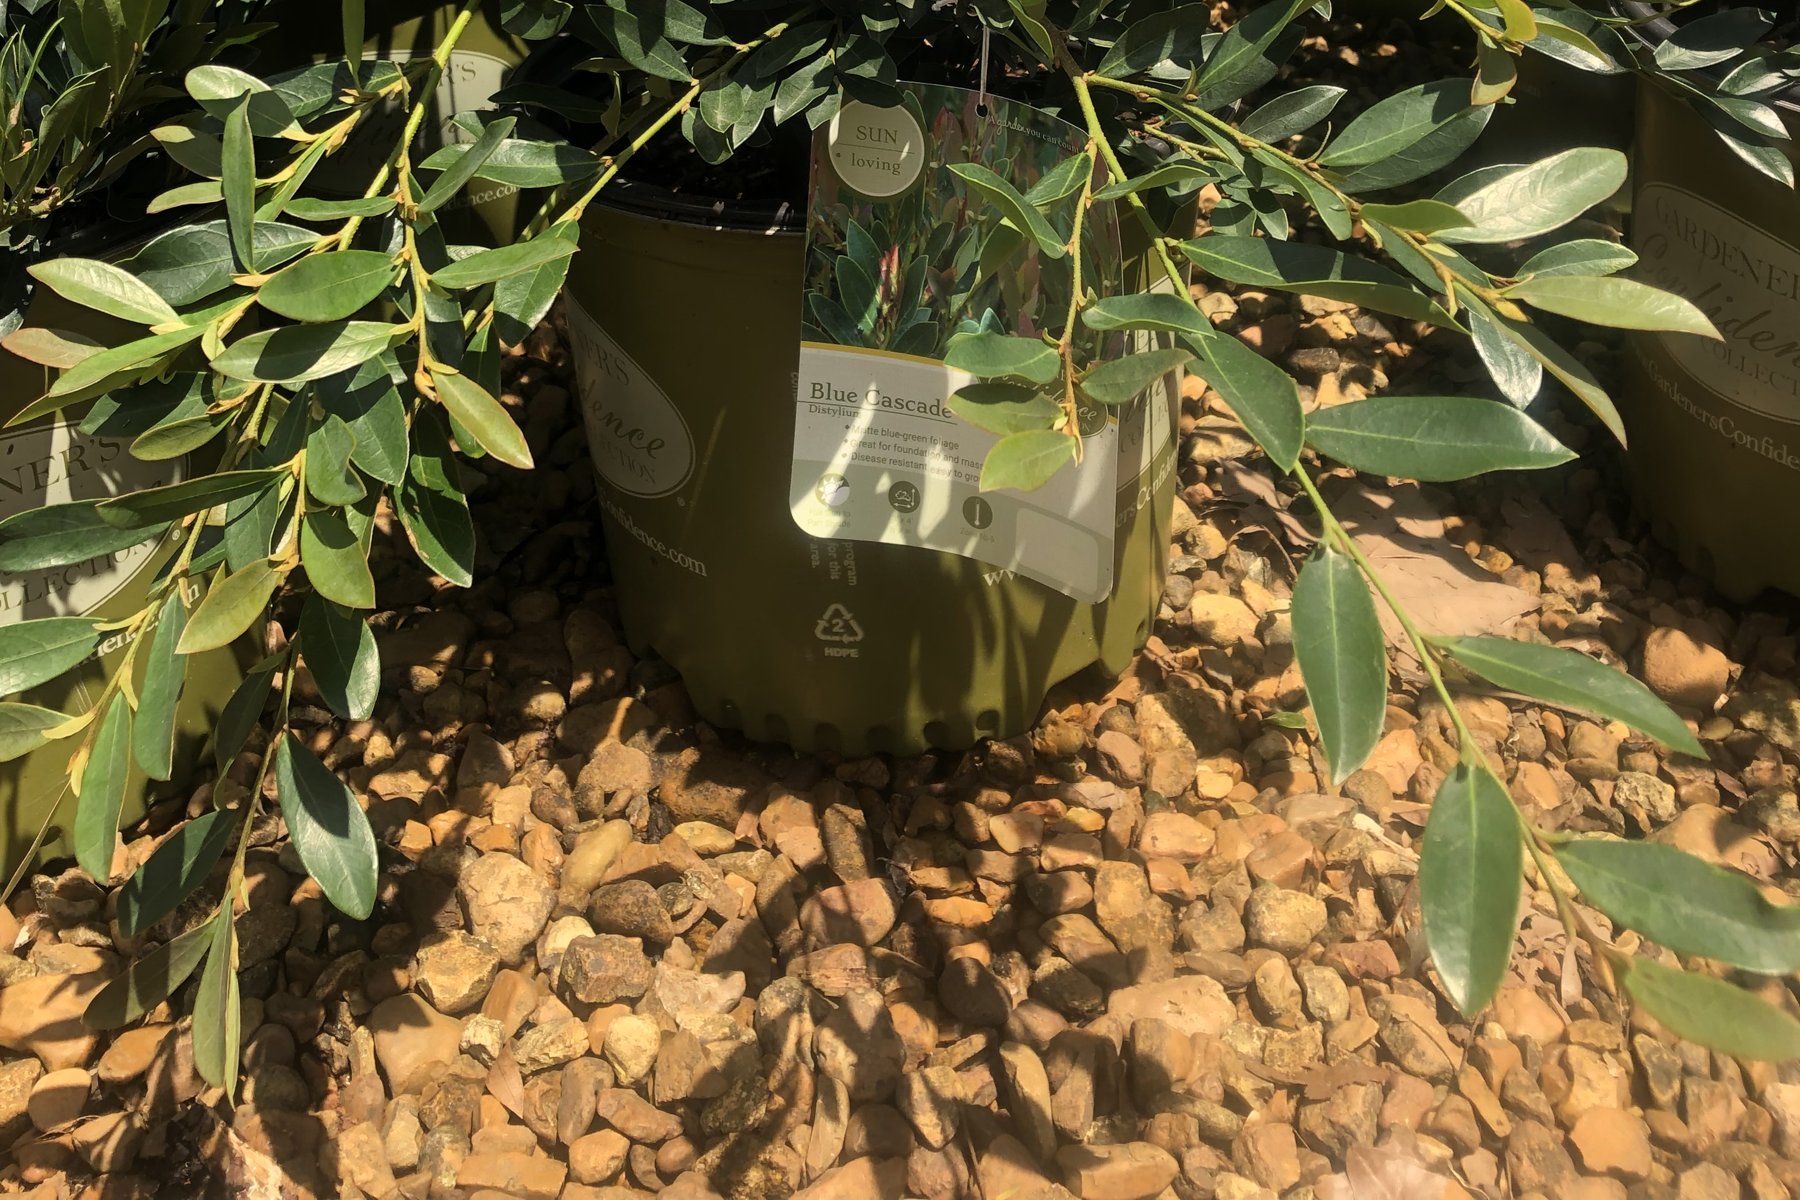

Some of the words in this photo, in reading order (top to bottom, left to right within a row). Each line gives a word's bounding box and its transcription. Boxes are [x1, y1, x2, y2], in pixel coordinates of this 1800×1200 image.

[855, 124, 898, 145] SUN
[996, 116, 1026, 136] garden
[1026, 126, 1041, 138] you
[1042, 133, 1057, 144] can
[850, 152, 901, 176] loving
[809, 381, 858, 404] Blue
[865, 388, 953, 419] Cascade
[852, 425, 879, 436] Matte
[881, 428, 928, 443] blue-green
[929, 435, 960, 450] foliage
[850, 439, 876, 449] Great
[878, 440, 891, 451] for
[893, 443, 941, 460] foundation
[943, 454, 959, 464] and
[851, 452, 887, 464] Disease
[888, 457, 928, 471] resistant
[930, 467, 952, 479] easy
[953, 469, 963, 478] to
[964, 473, 981, 483] gro
[828, 561, 842, 580] this
[841, 541, 857, 586] program
[831, 618, 846, 633] 2
[824, 647, 860, 658] HDPE
